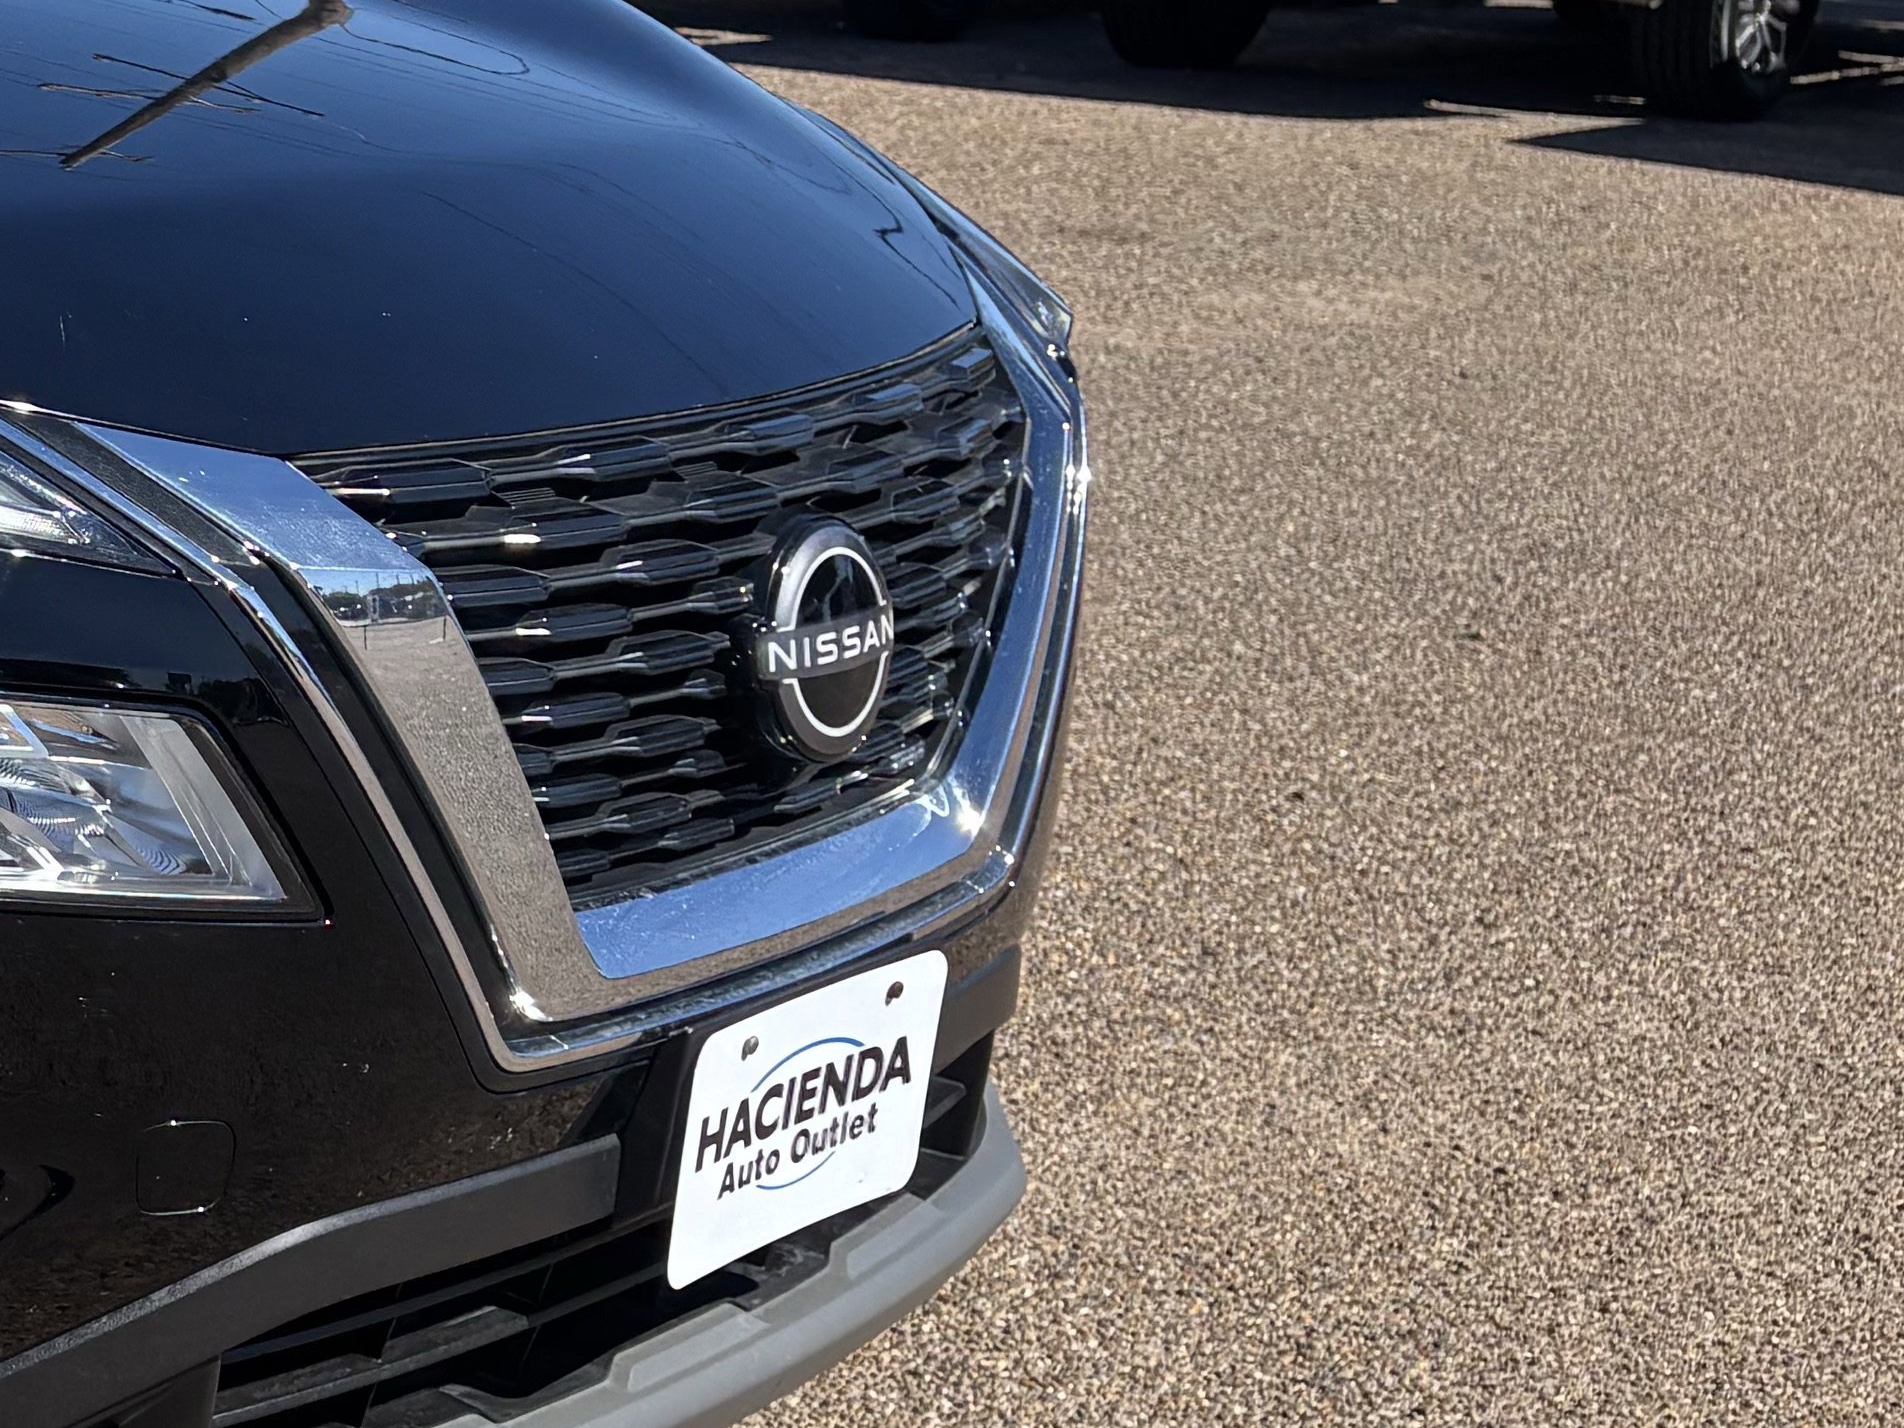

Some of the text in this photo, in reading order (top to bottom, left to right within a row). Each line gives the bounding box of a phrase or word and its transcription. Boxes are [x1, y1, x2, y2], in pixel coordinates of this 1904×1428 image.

[767, 613, 894, 673] NISSAN
[695, 1035, 912, 1173] HACIENDA
[717, 1102, 879, 1201] Auto Outlet
